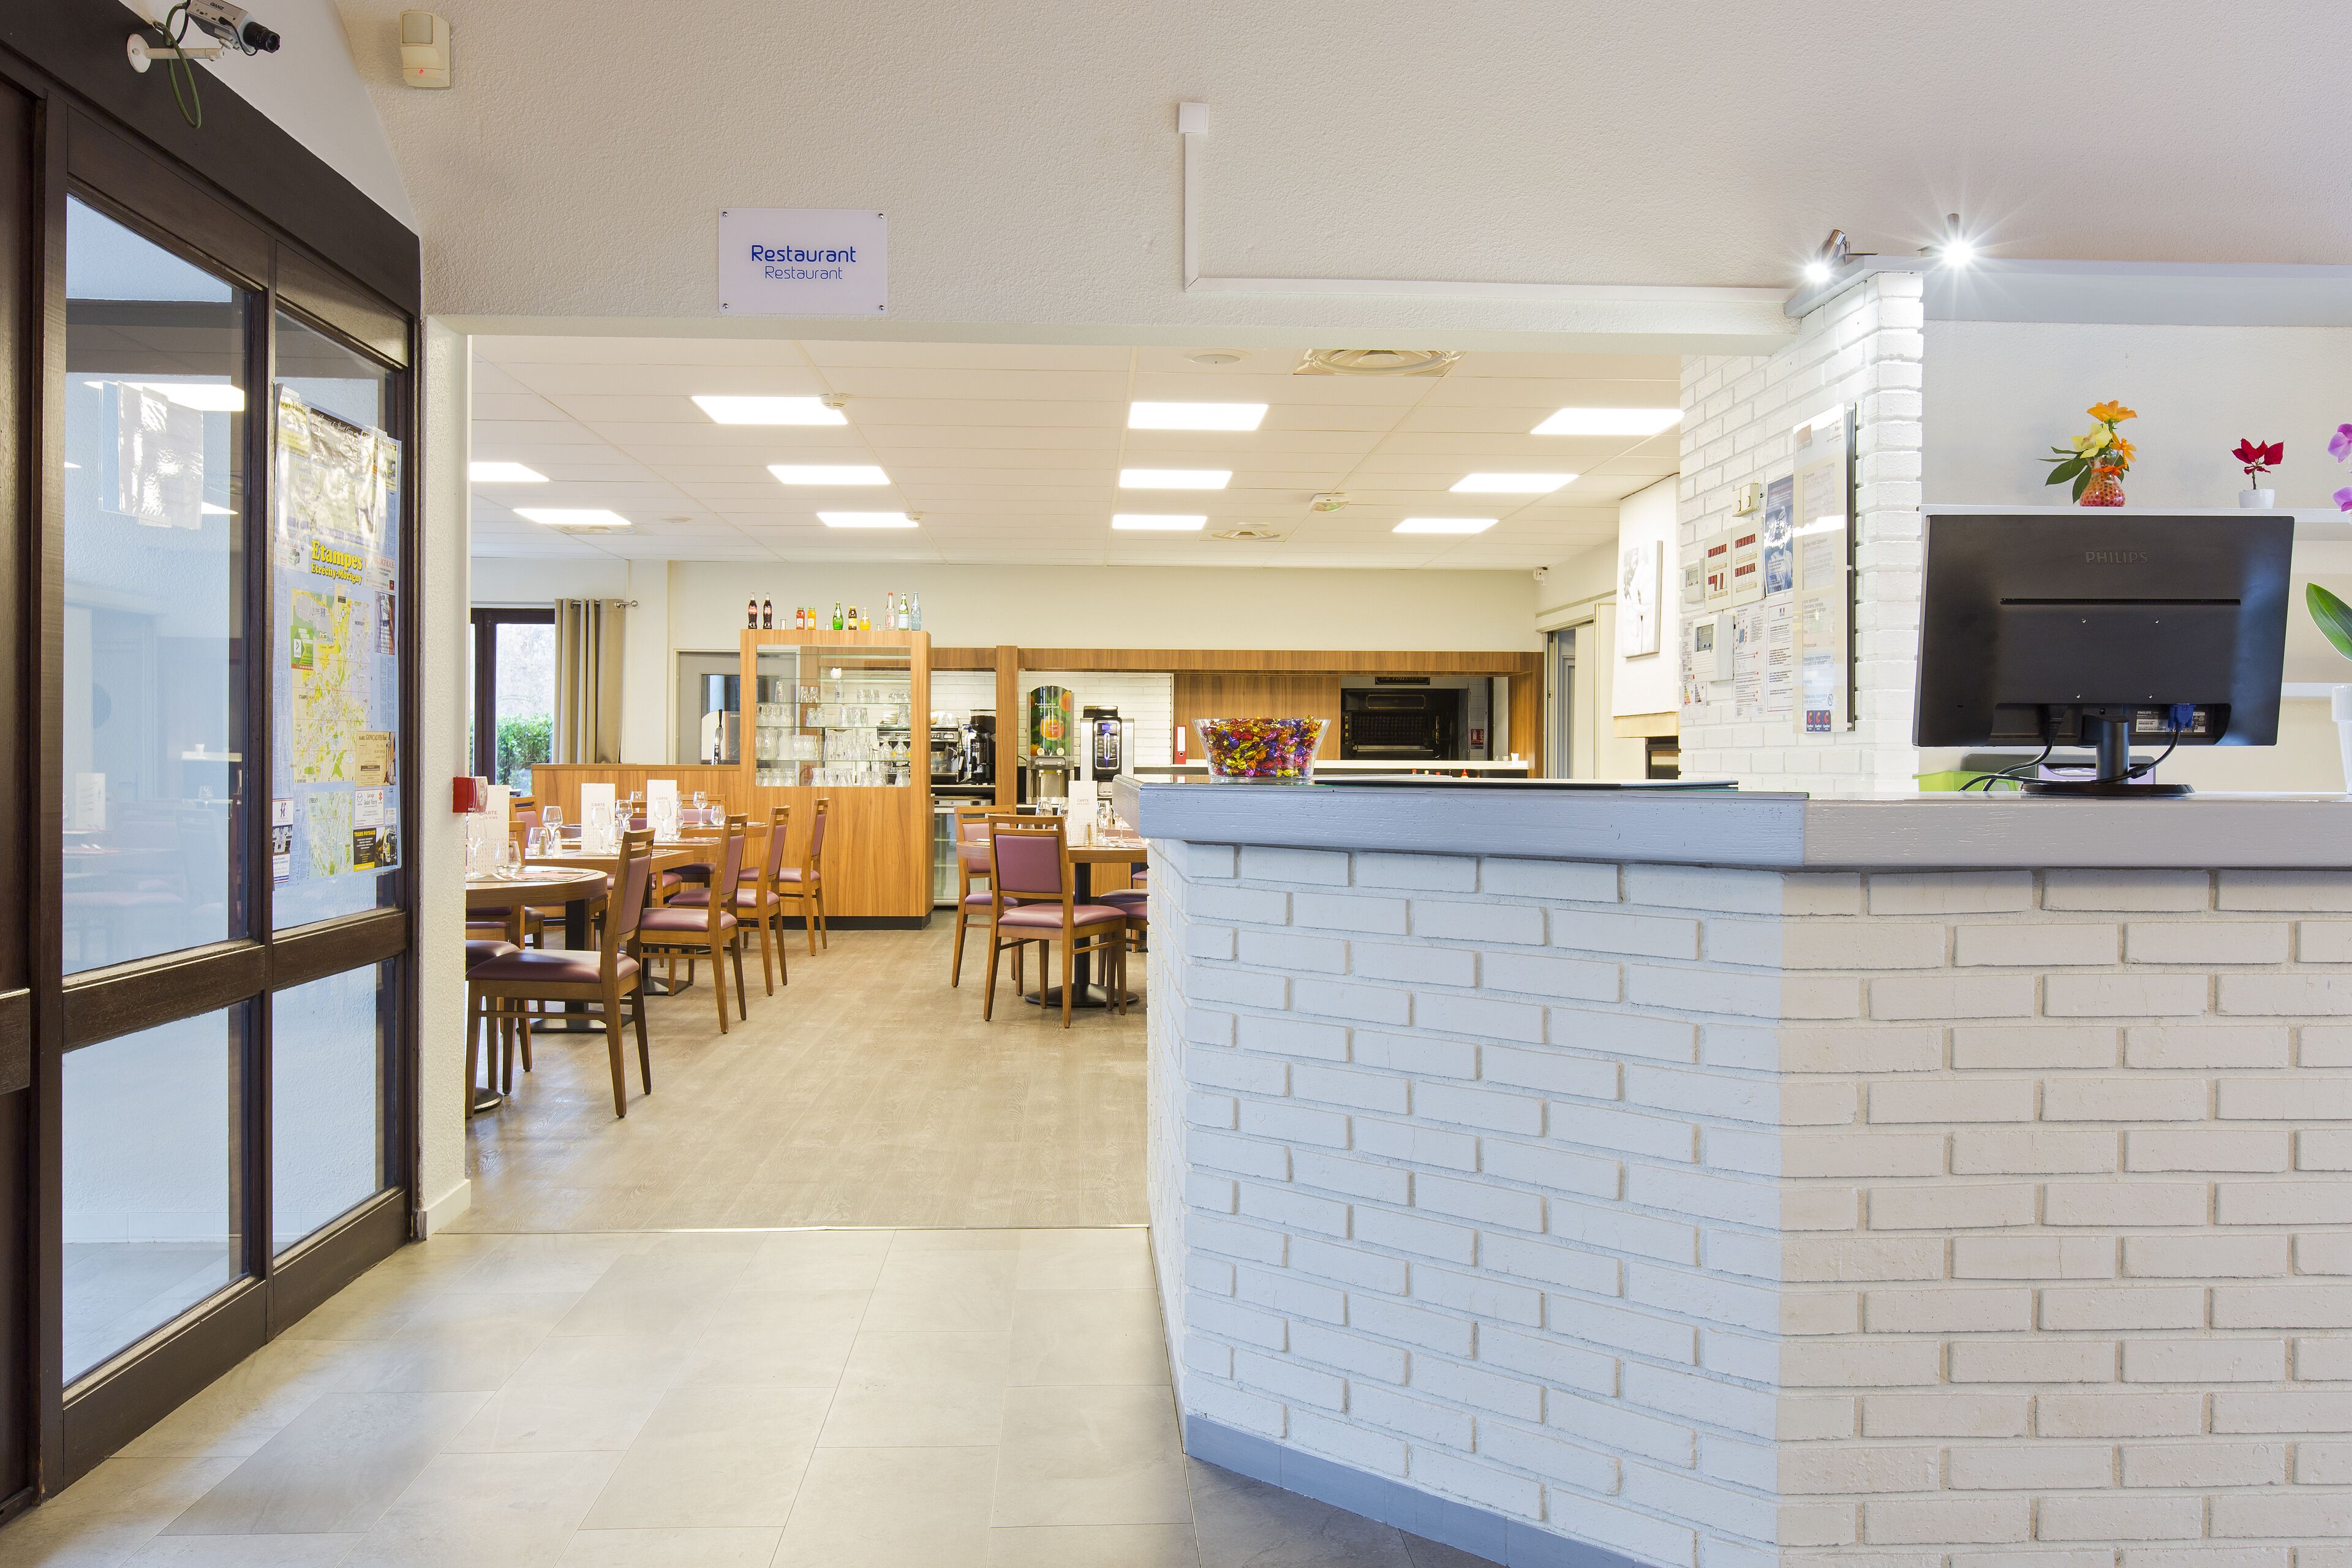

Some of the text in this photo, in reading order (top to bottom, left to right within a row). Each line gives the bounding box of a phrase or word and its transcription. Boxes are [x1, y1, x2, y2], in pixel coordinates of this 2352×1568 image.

[210, 2, 225, 11] GANZ
[751, 244, 856, 263] Restaurant
[765, 266, 843, 280] Restaurant
[311, 539, 363, 571] Etampes
[2085, 551, 2148, 564] PHILIPS
